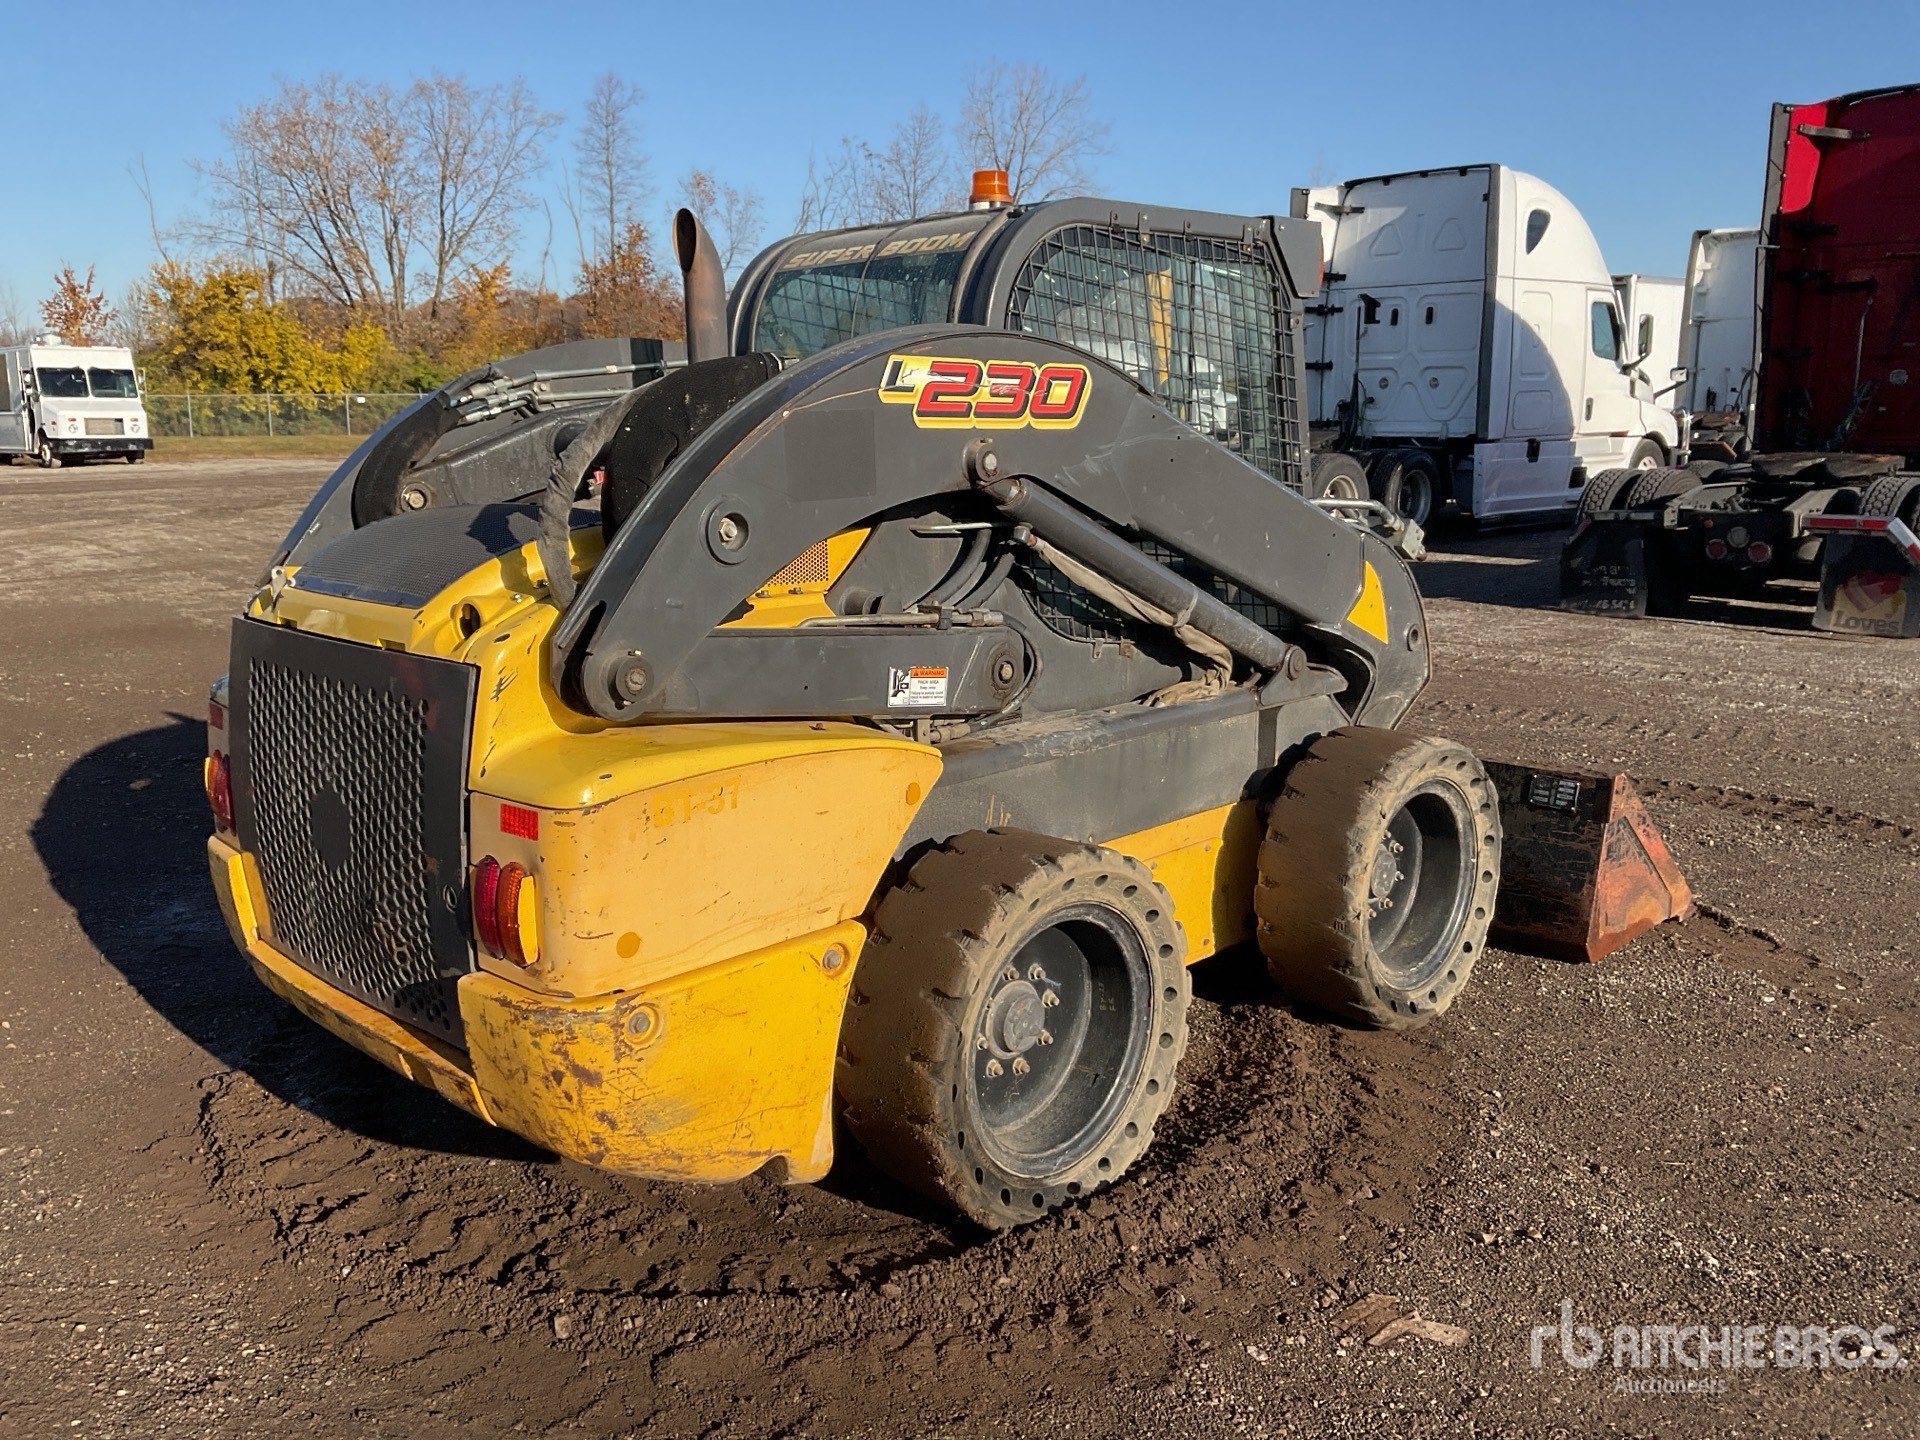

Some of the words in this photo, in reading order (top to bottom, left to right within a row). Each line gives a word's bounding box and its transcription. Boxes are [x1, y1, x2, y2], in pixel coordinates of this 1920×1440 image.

[784, 244, 876, 268] SUPER
[877, 231, 977, 257] BOOM
[880, 357, 1089, 422] L230
